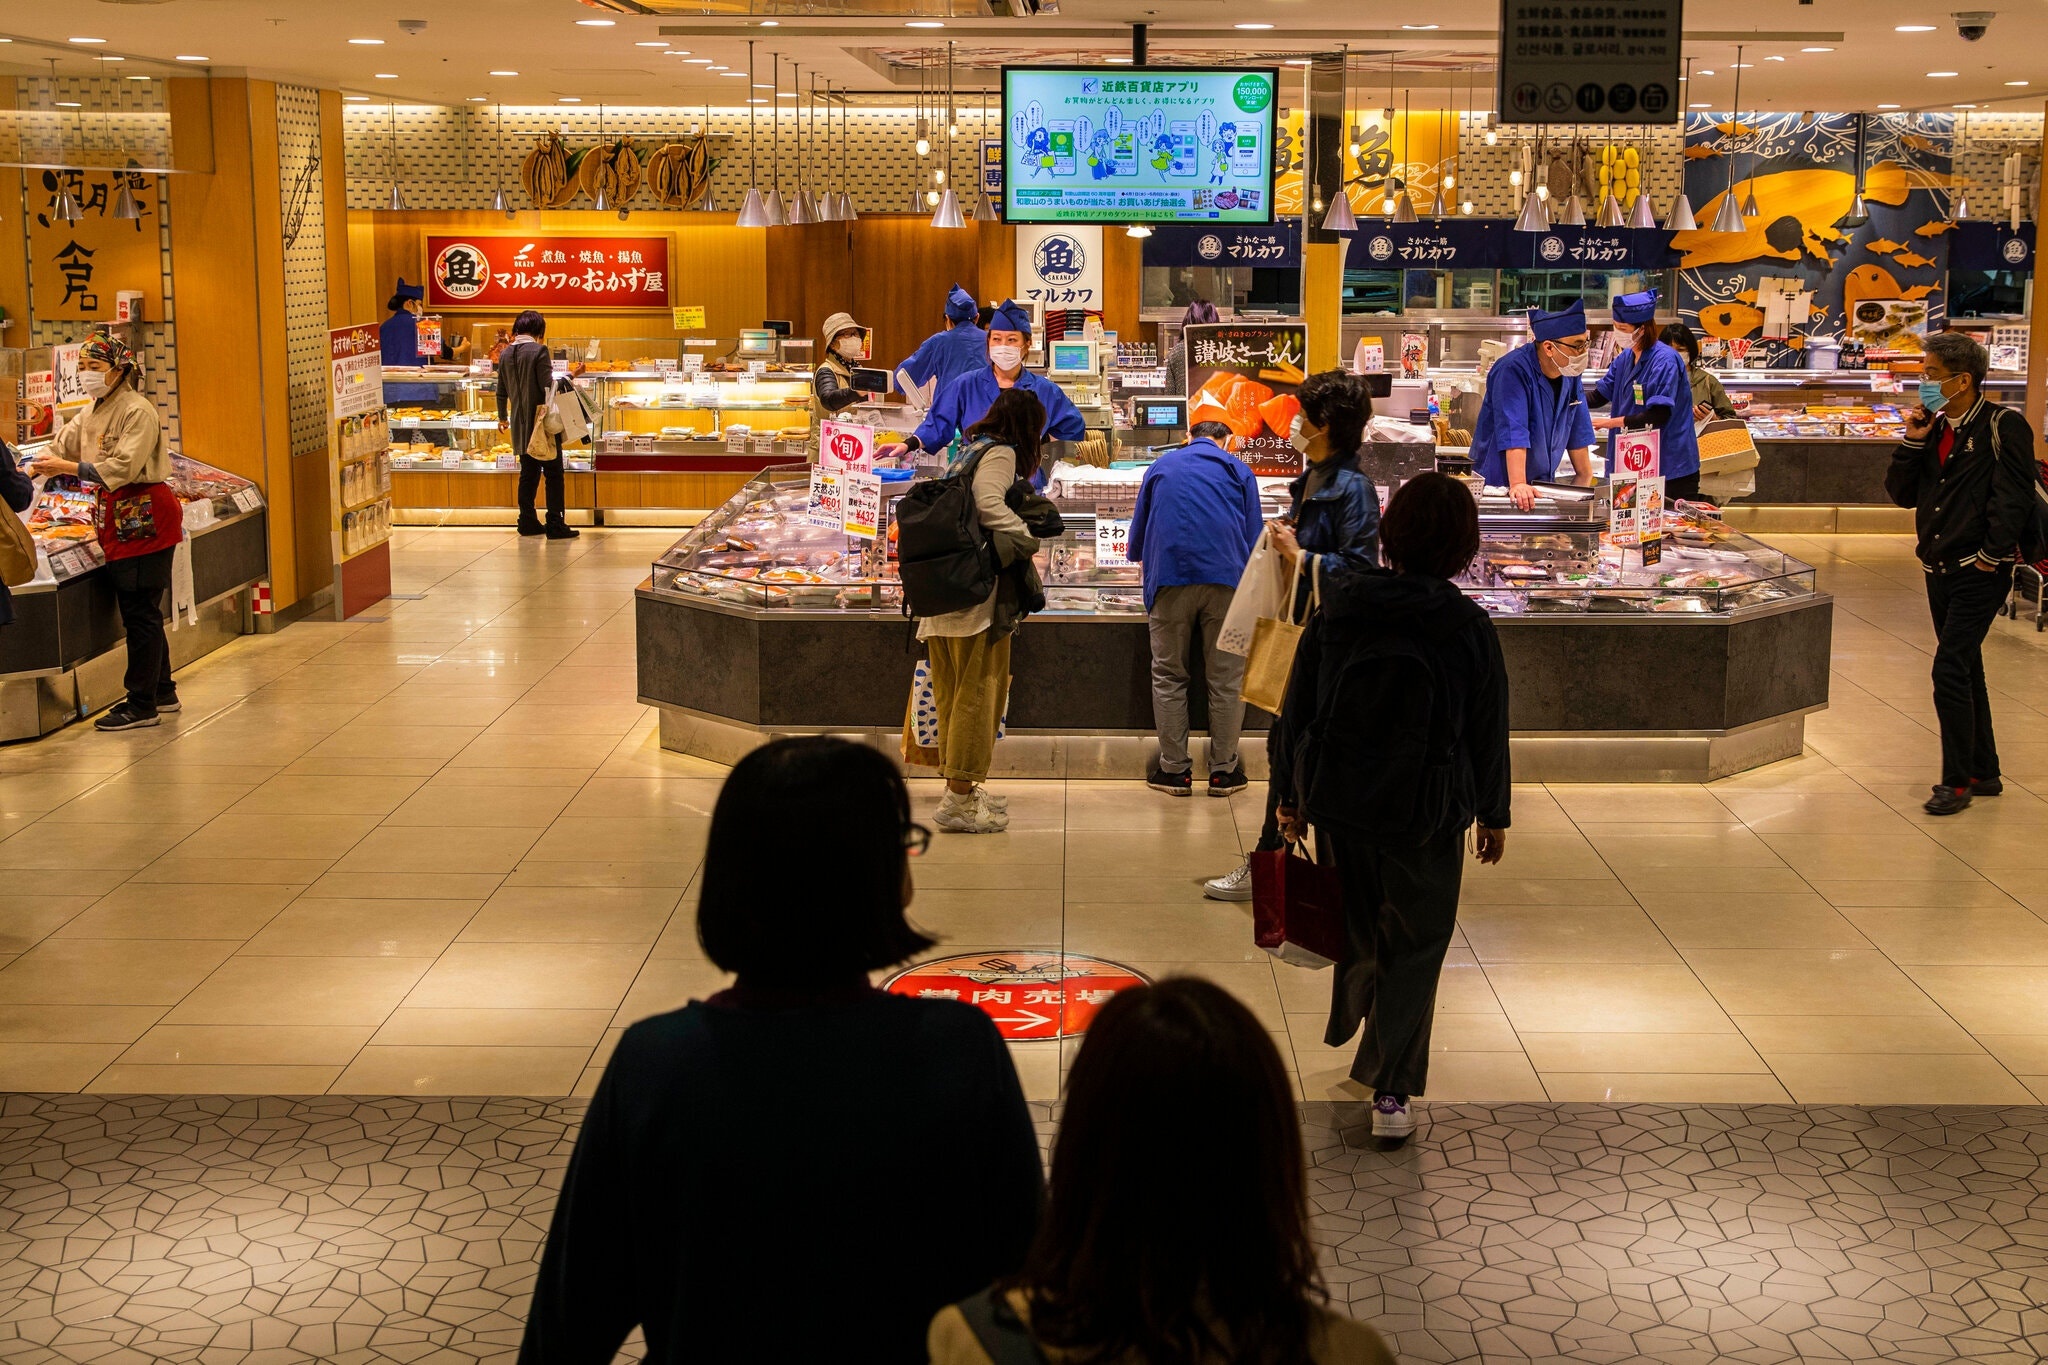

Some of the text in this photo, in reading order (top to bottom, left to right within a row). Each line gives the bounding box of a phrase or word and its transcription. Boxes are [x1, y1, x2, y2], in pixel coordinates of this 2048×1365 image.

[1101, 80, 1199, 93] 近鉄百貨店アプリ
[1237, 87, 1267, 96] 150,000
[1118, 198, 1187, 207] お買いあげ抽選会
[1235, 235, 1276, 245] さかな一筋
[1406, 237, 1449, 246] さかな一筋
[1578, 237, 1620, 247] さかな一筋
[541, 250, 643, 264] 煮魚・焼魚・揚魚
[1040, 238, 1081, 275] 魚
[1227, 244, 1286, 259] マルカワ
[1397, 246, 1458, 261] マルカワ
[1569, 246, 1628, 262] マルカワ
[442, 249, 484, 288] 魚
[493, 267, 665, 293] マルカワのおかず屋
[1026, 288, 1094, 304] マルカワ
[1194, 340, 1302, 365] 讃岐さーもん
[825, 426, 841, 437] 春の
[838, 438, 854, 459] 旬
[1235, 435, 1293, 449] 驚きのうまさ
[1619, 441, 1632, 452] 春の
[1632, 449, 1644, 468] 旬
[845, 461, 868, 473] 食材市
[813, 482, 842, 496] 天然ぶり
[821, 495, 841, 509] ¥601
[856, 509, 875, 523] ¥432
